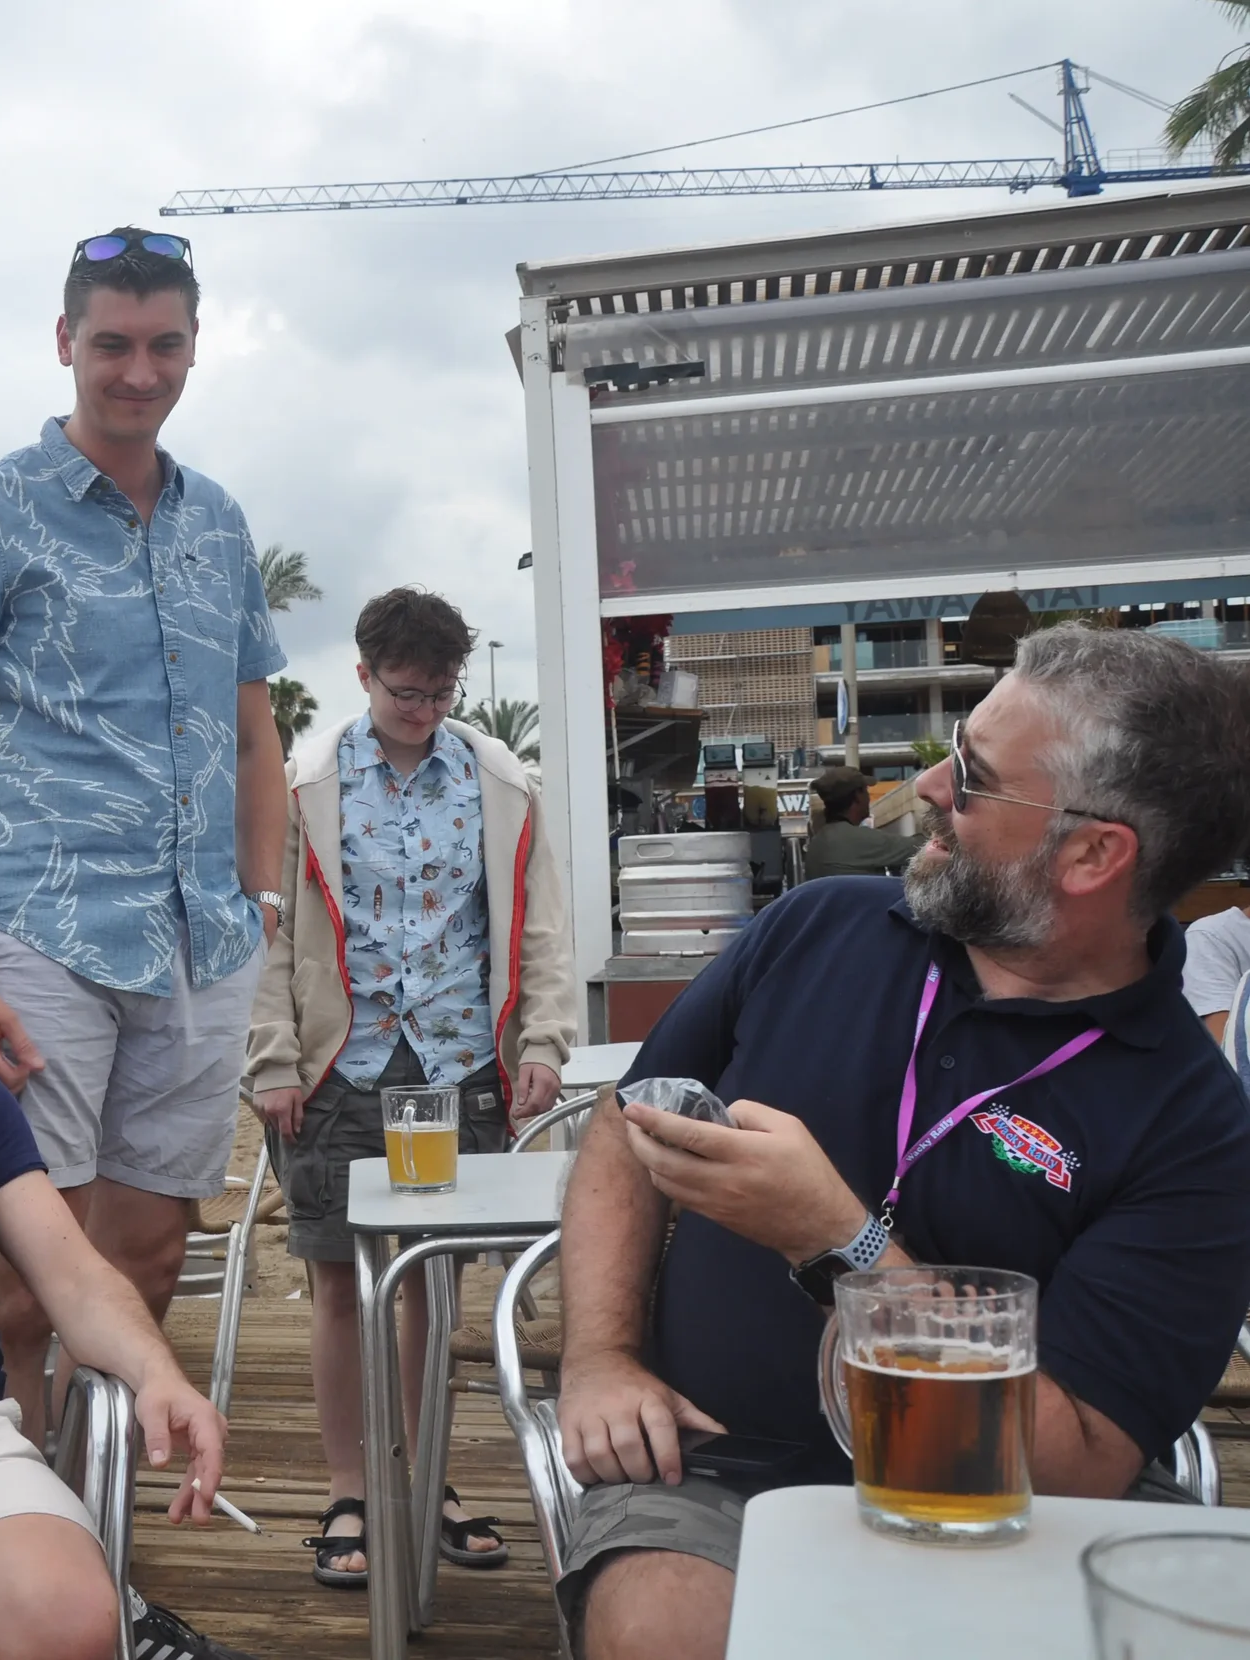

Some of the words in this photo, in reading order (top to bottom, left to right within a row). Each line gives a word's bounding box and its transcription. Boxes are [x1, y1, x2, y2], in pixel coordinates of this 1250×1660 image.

[906, 1138, 932, 1162] Wacky
[930, 1116, 954, 1139] Rally
[994, 1119, 1025, 1149] Wacky
[1026, 1144, 1058, 1169] Rally
